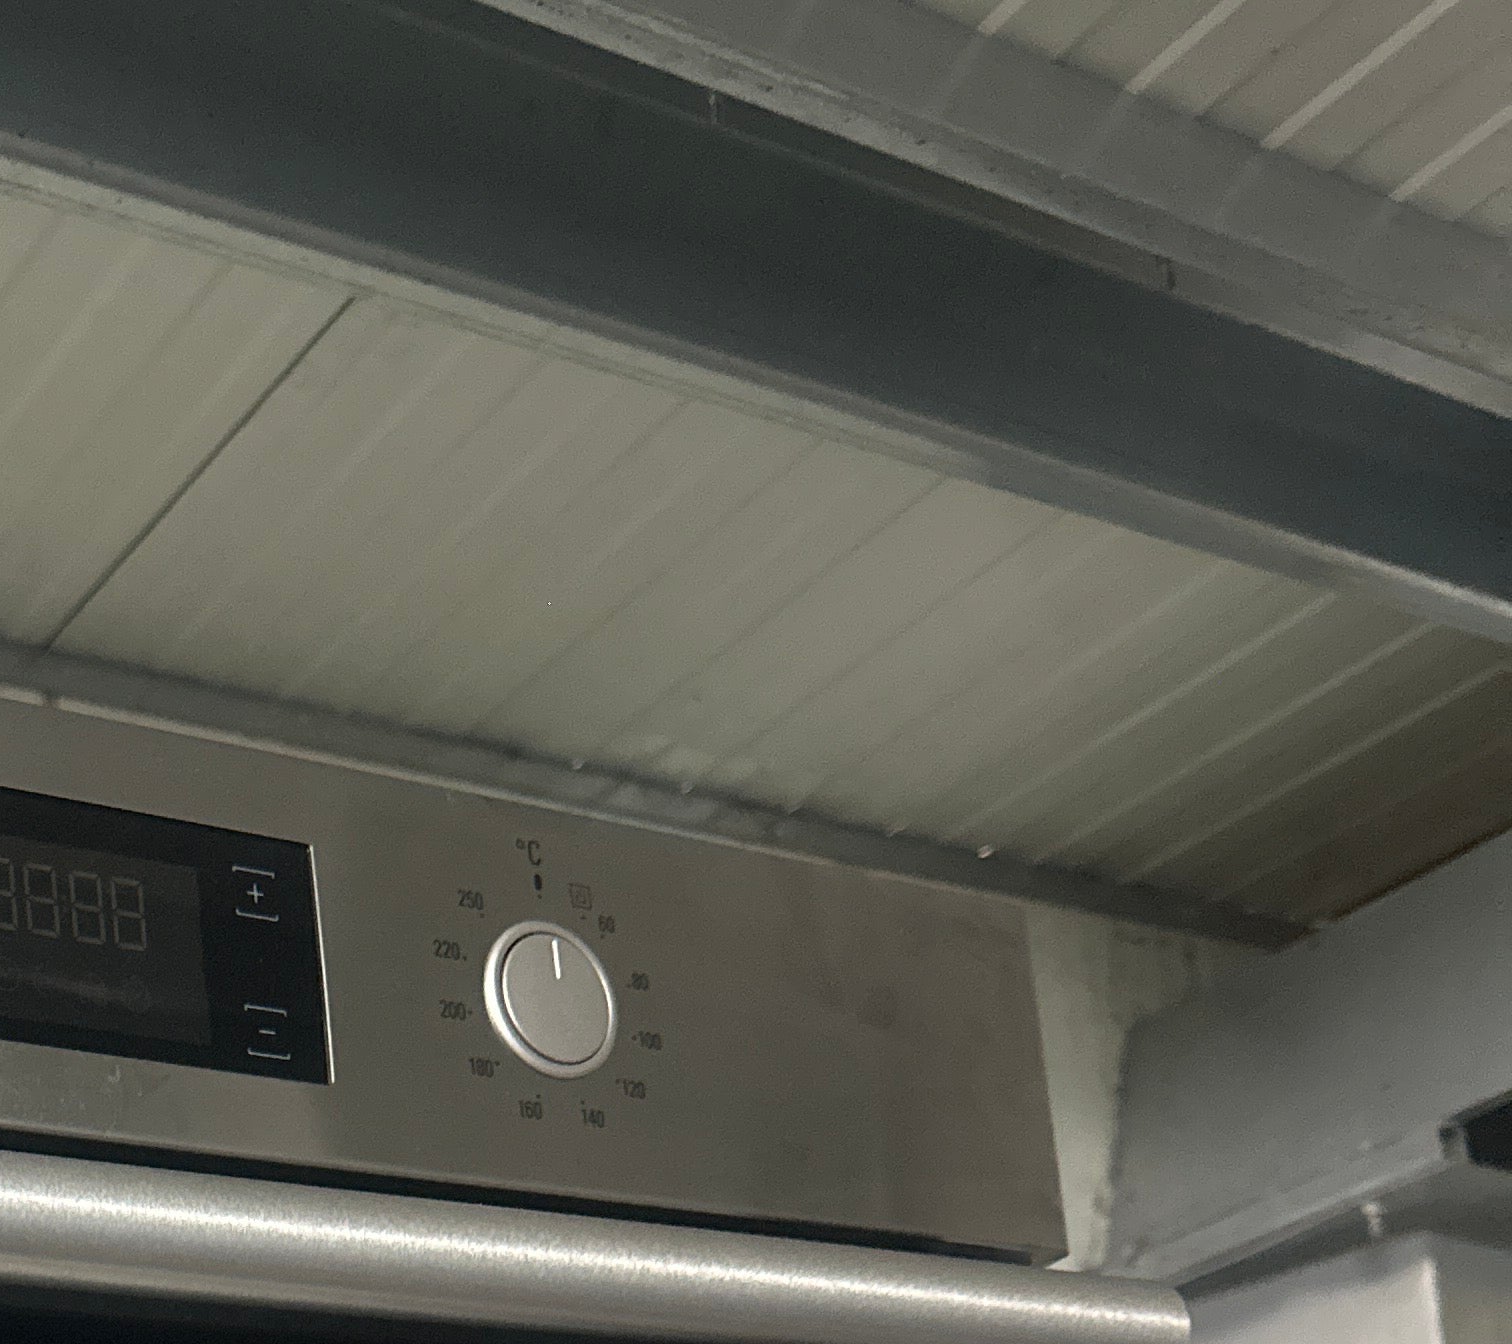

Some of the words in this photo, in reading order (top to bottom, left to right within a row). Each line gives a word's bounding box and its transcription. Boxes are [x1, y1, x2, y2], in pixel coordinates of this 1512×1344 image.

[515, 838, 541, 867] °C
[457, 890, 484, 911] 250
[433, 940, 461, 961] 220
[439, 1000, 466, 1021] 200
[640, 1031, 662, 1051] 100
[623, 1079, 646, 1099] 120
[581, 1108, 605, 1129] 140
